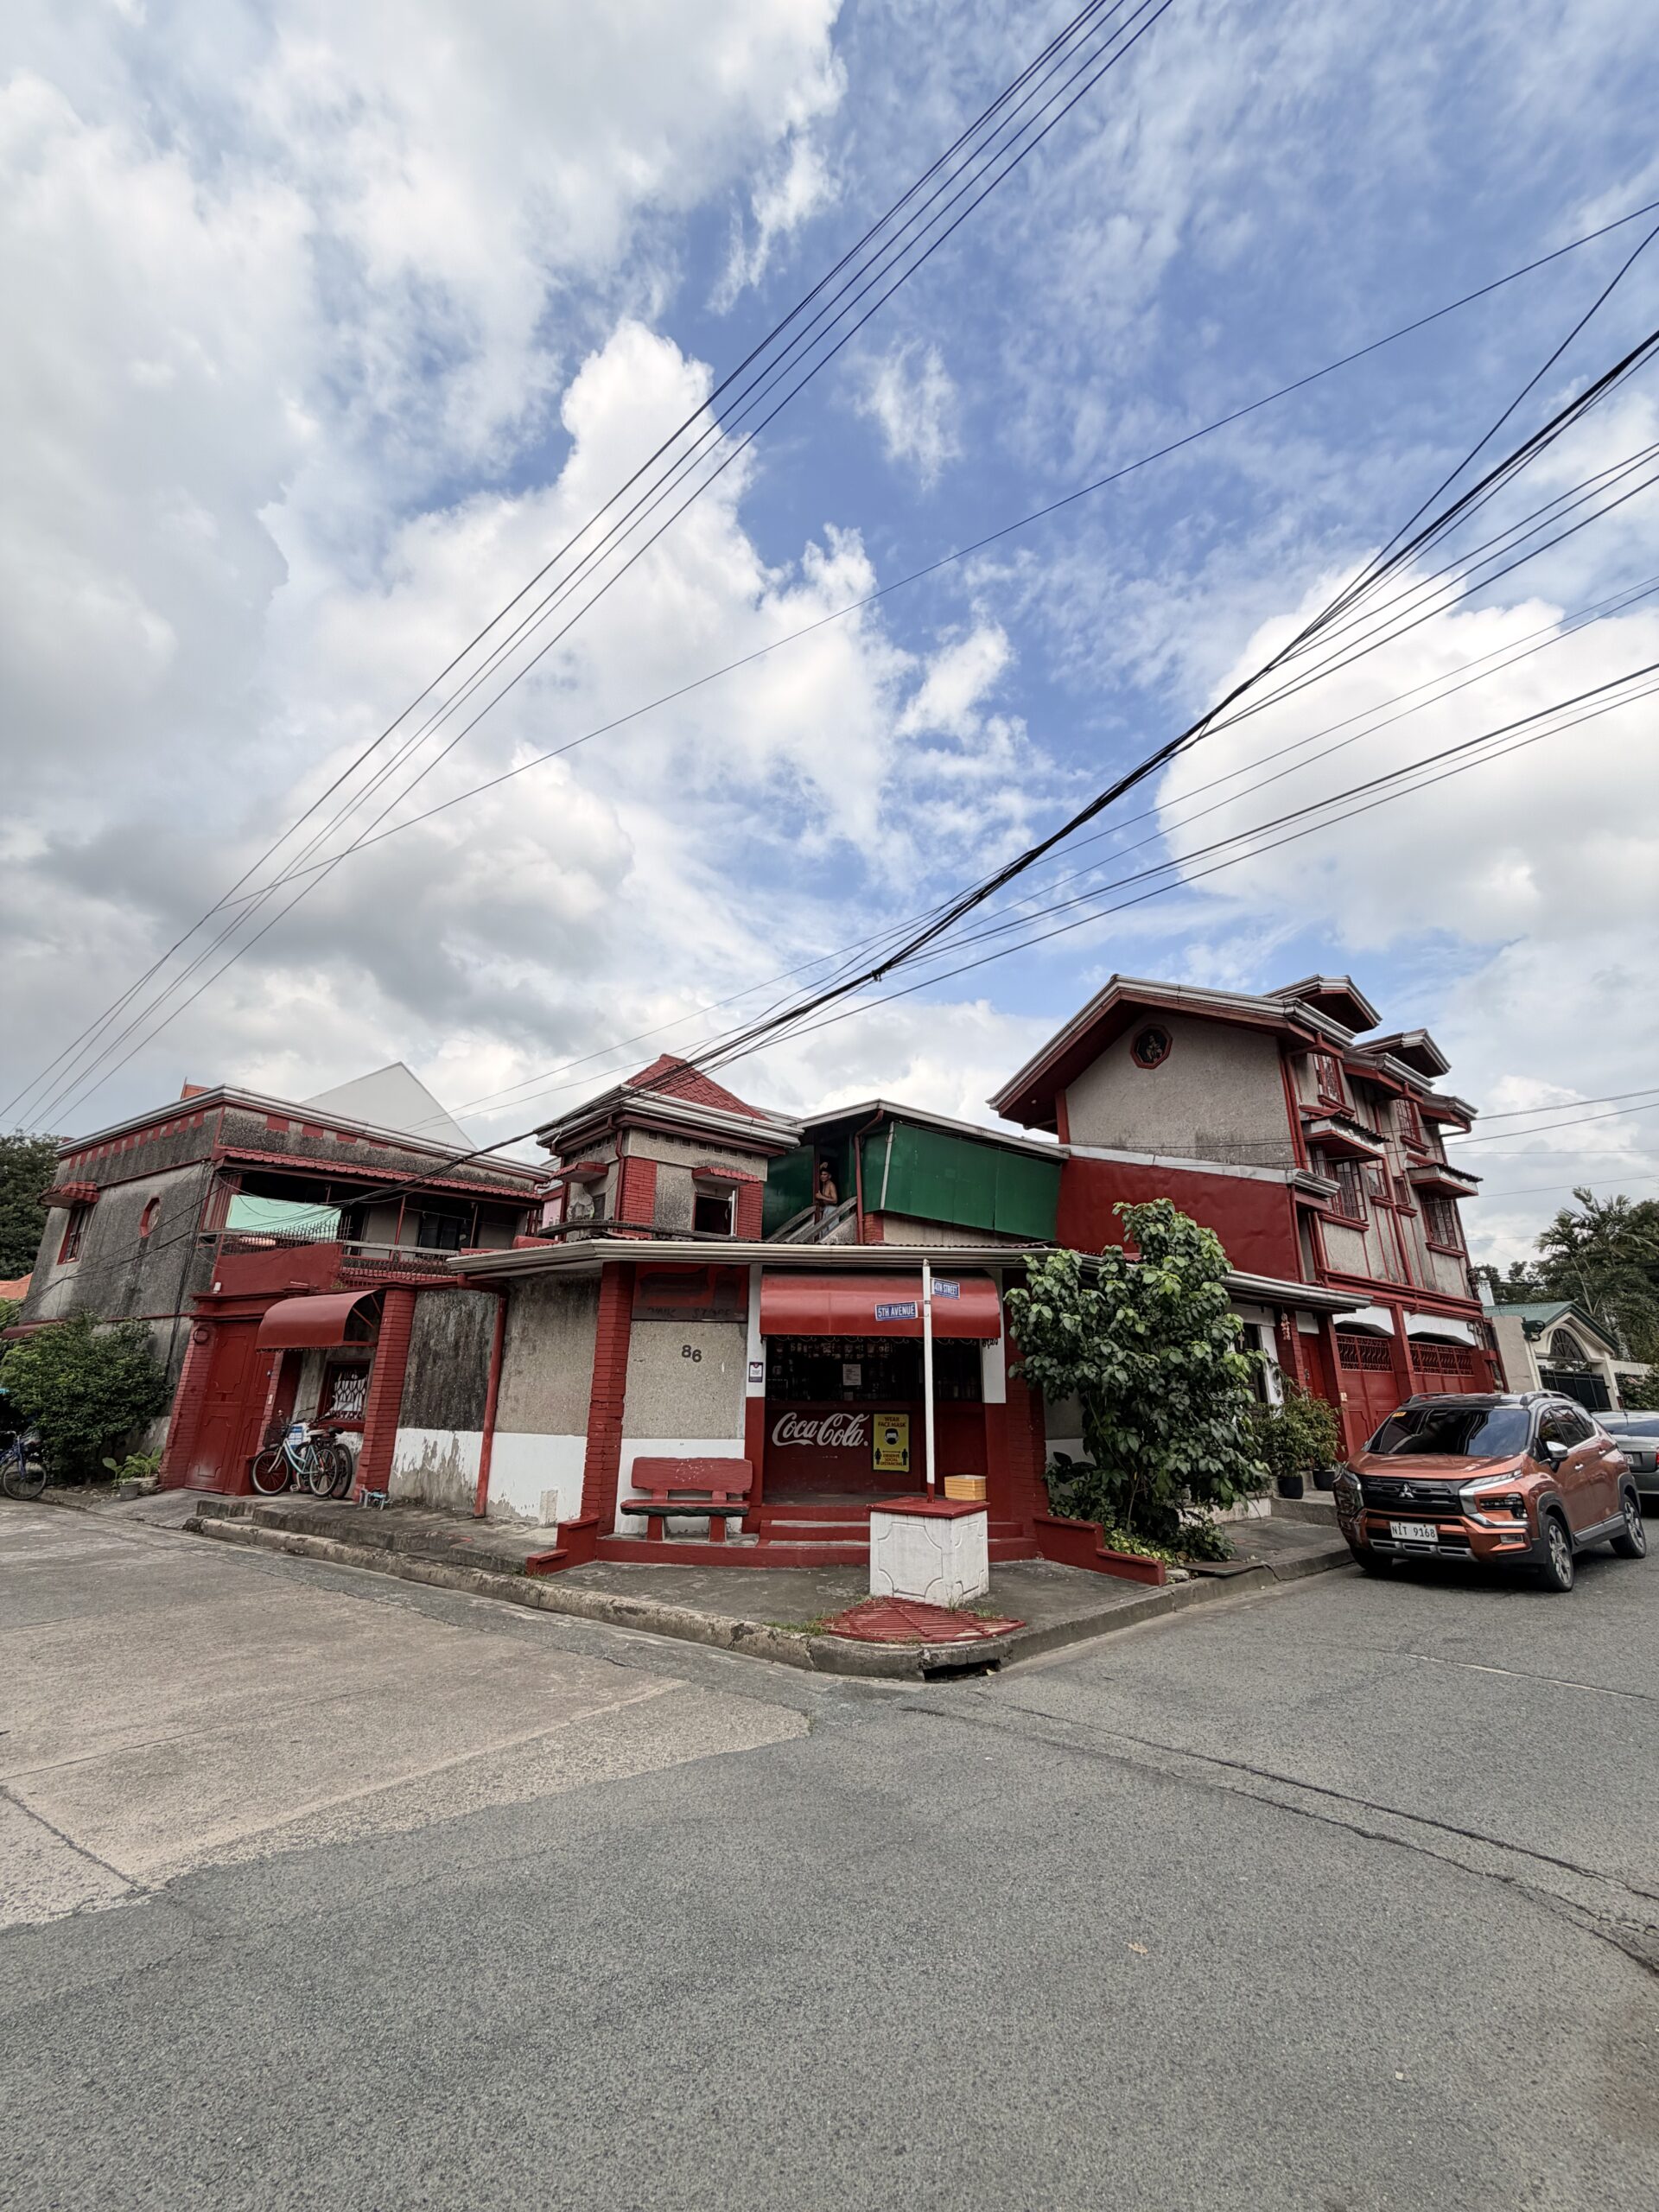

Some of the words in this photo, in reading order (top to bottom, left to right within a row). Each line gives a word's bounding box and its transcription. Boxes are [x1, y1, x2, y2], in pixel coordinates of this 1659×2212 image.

[943, 1284, 957, 1295] STREET
[878, 1307, 890, 1317] 5TH
[891, 1305, 914, 1316] AVENUE
[682, 1344, 702, 1363] 86
[1392, 1526, 1407, 1535] NIT
[1414, 1528, 1435, 1537] 9168
